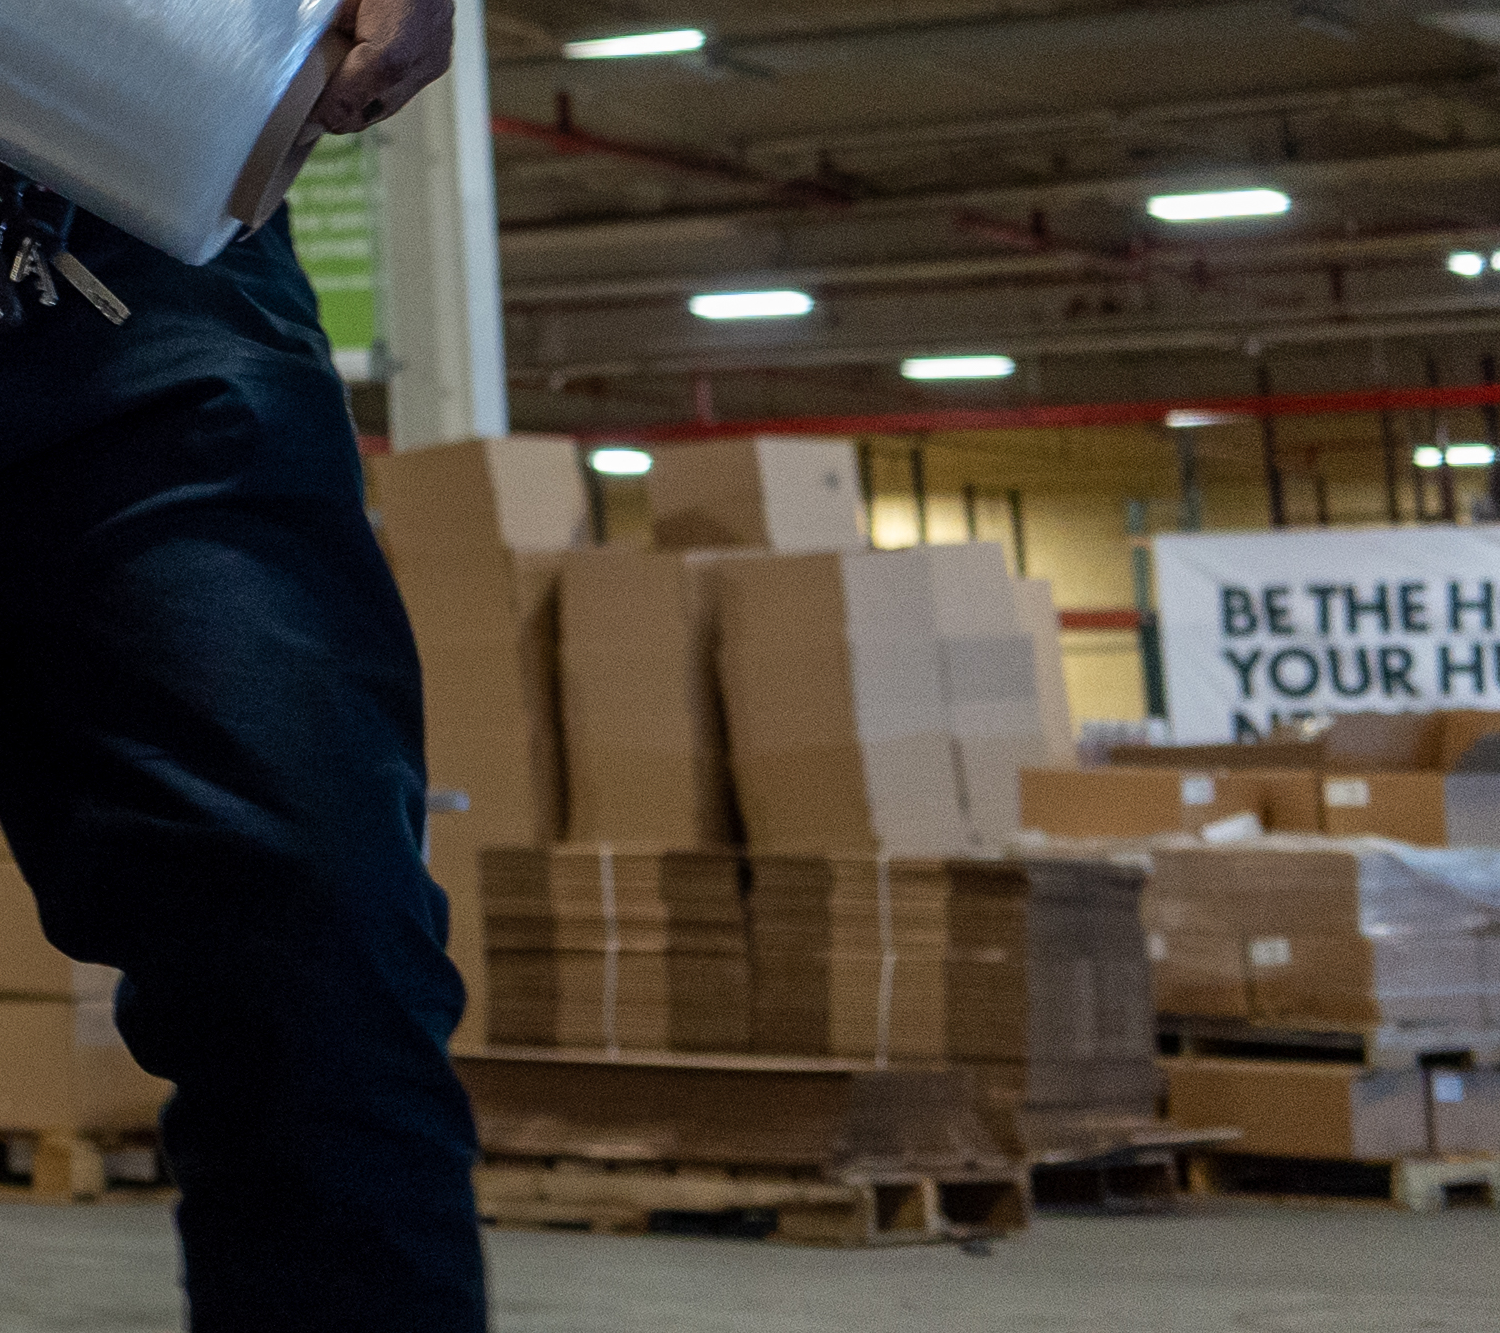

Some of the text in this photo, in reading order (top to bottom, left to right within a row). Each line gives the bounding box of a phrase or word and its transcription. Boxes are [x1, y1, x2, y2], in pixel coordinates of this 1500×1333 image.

[1221, 583, 1294, 636] BE
[1307, 581, 1434, 634] THE
[1221, 644, 1421, 698] YOUR
